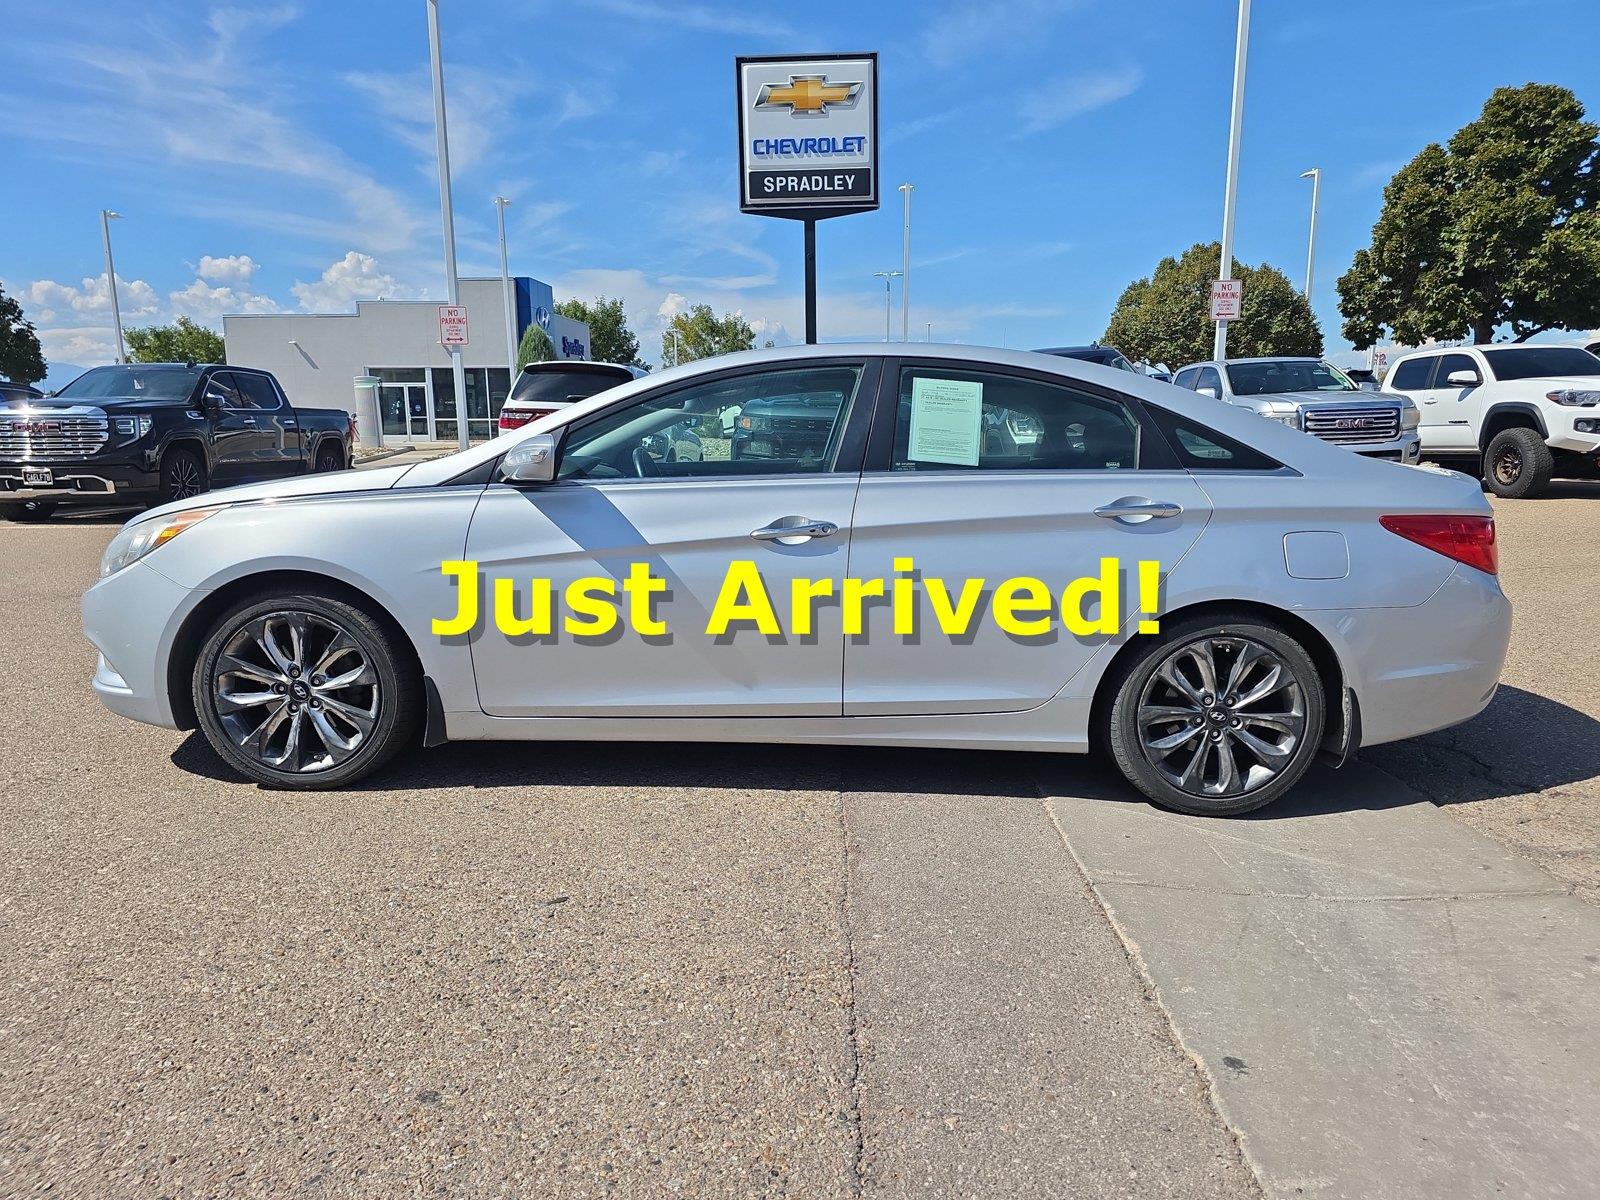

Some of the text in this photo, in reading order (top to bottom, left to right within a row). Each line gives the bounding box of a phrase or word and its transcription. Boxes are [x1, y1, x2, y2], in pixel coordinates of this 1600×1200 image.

[753, 137, 866, 155] CHEVROLET
[763, 174, 856, 192] SPRADLEY
[1221, 283, 1233, 291] NO
[1213, 292, 1239, 300] PARKING
[447, 309, 459, 317] NO
[441, 317, 466, 325] PARKING
[1336, 418, 1375, 429] GMC
